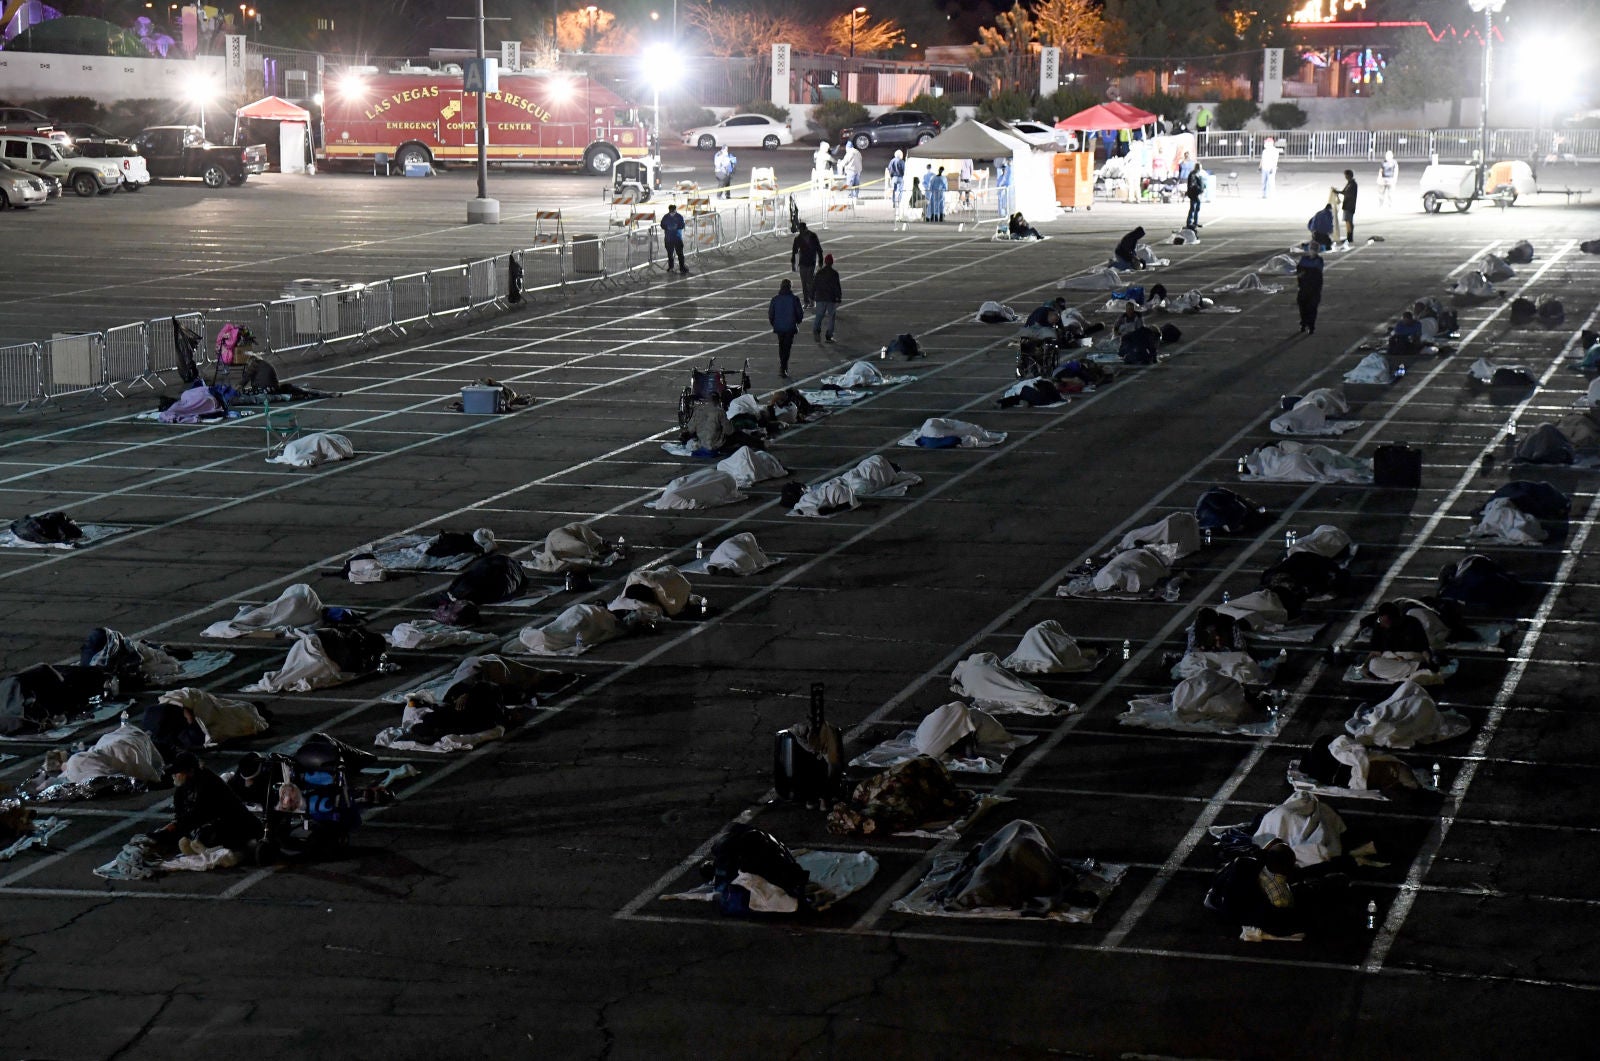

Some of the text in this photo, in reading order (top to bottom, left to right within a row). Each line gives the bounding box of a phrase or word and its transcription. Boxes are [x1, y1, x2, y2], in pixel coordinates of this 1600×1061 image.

[466, 62, 482, 88] A
[365, 99, 391, 120] LAS
[392, 86, 439, 104] VEGAS
[504, 92, 551, 123] RESCUE
[386, 122, 437, 130] EMERGENCY
[446, 122, 488, 130] COMMA
